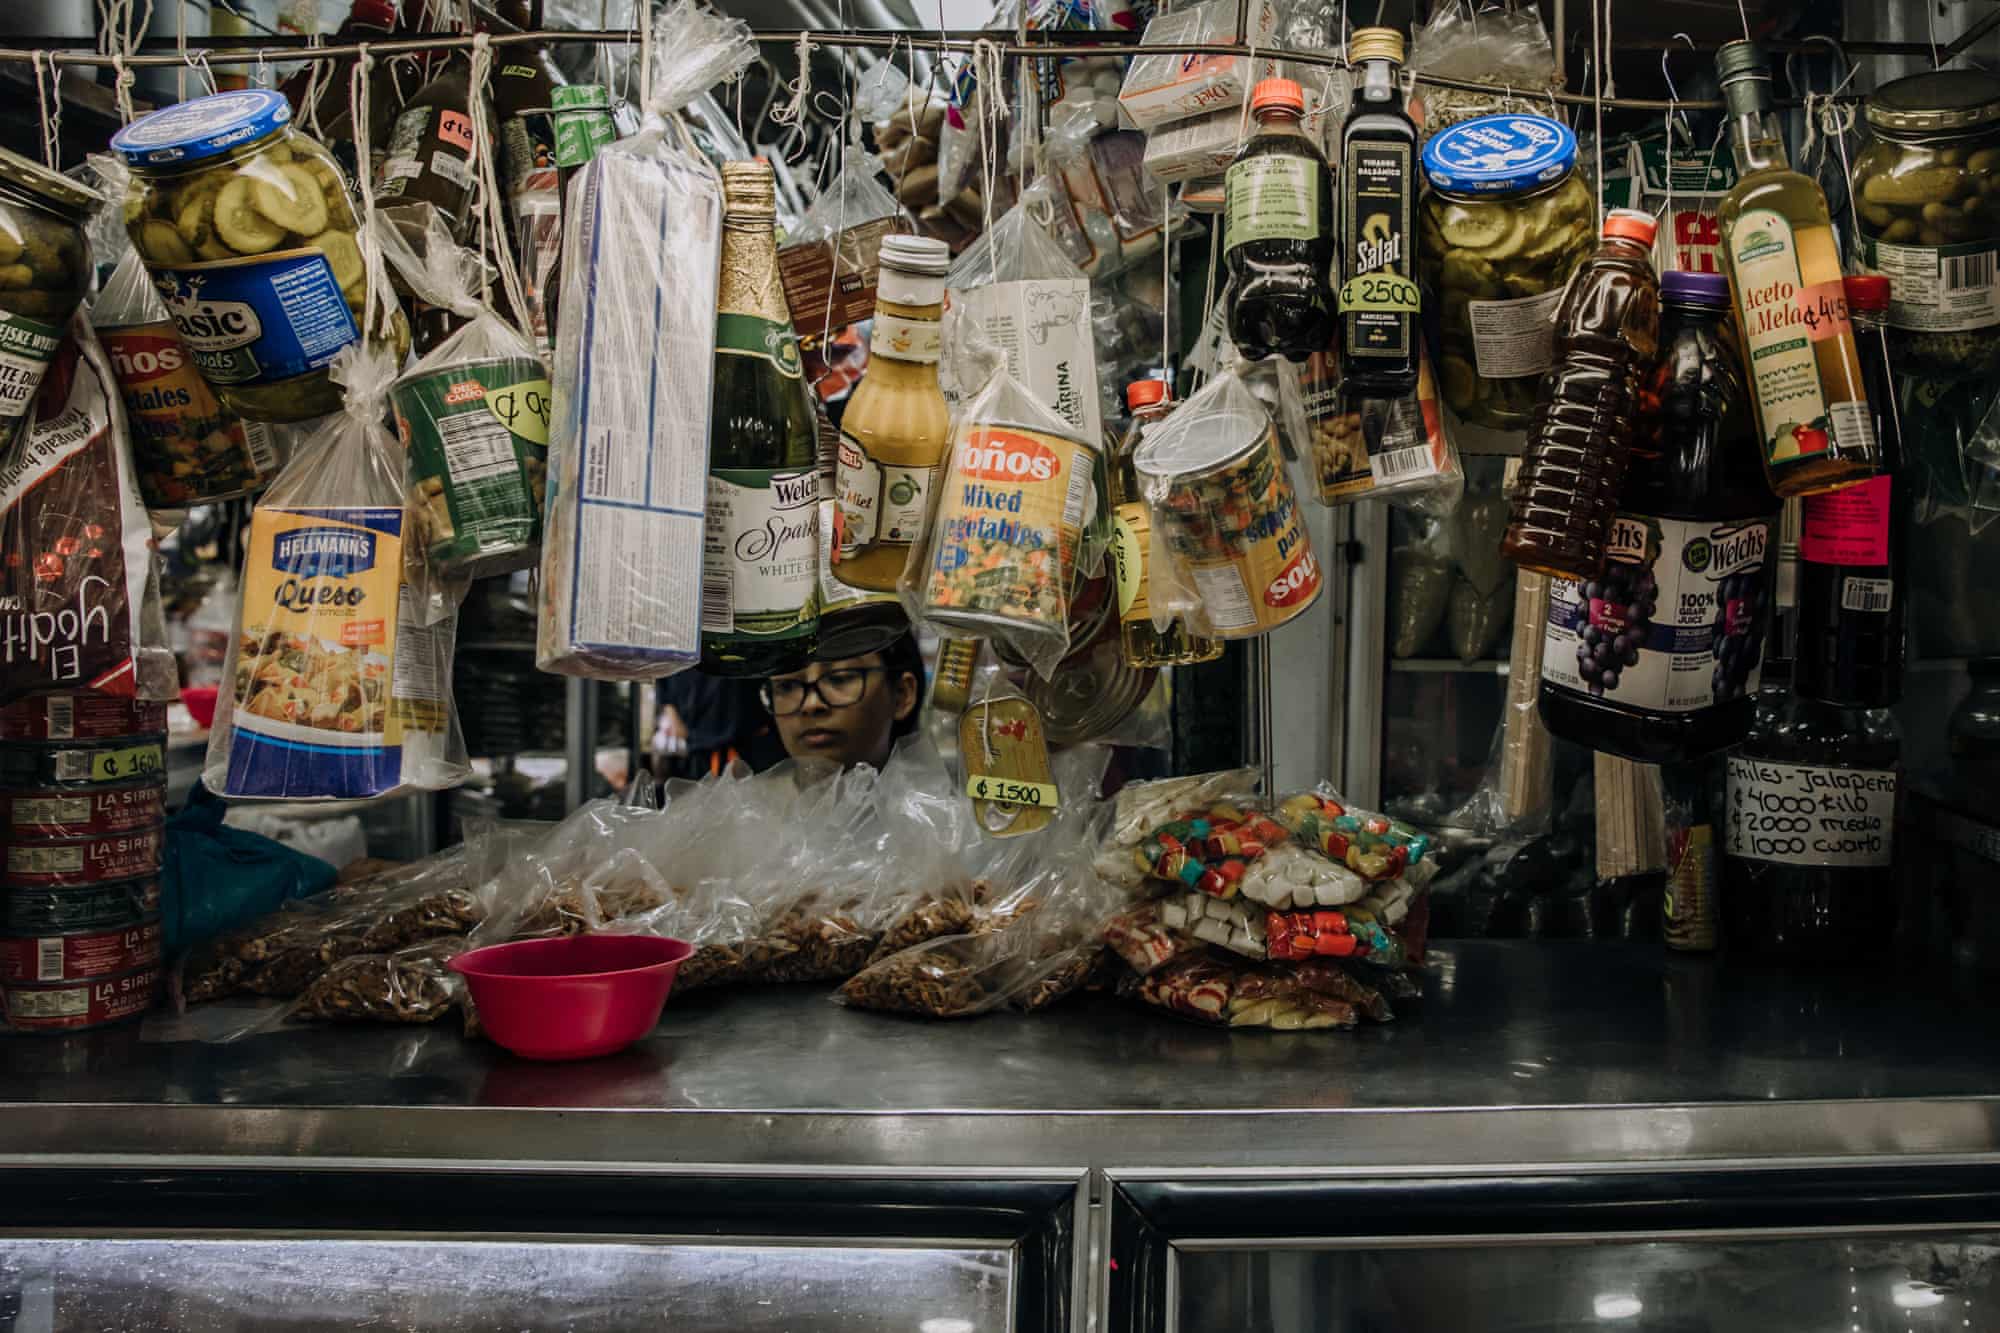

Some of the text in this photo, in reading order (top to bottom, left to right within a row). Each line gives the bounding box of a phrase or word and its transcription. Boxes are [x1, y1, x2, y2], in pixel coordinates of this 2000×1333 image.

[1356, 232, 1401, 274] Salat
[1362, 280, 1418, 306] 2500
[1745, 280, 1793, 312] Aceto
[176, 306, 248, 338] asic
[1759, 303, 1802, 335] Mela
[112, 343, 183, 376] ños
[957, 440, 1052, 480] oños
[962, 484, 1023, 513] Mixed
[280, 535, 371, 559] HELLMANN'S
[1711, 529, 1765, 572] Welch's
[759, 562, 802, 577] WHITE
[274, 579, 367, 613] Queso
[1681, 592, 1715, 607] 100%
[0, 575, 109, 663] yodit
[51, 644, 81, 681] El
[1727, 760, 1782, 785] Chiles
[1796, 769, 1897, 796] Jalapeño
[96, 793, 118, 812] LA
[996, 782, 1041, 804] 1500
[1748, 787, 1816, 815] 4000
[1818, 792, 1868, 813] kilo
[1744, 812, 1811, 833] 2000
[1820, 815, 1881, 832] medio
[90, 842, 111, 861] LA
[1751, 834, 1806, 855] 1000
[1813, 833, 1881, 853] cuarto
[96, 983, 115, 1002] LA
